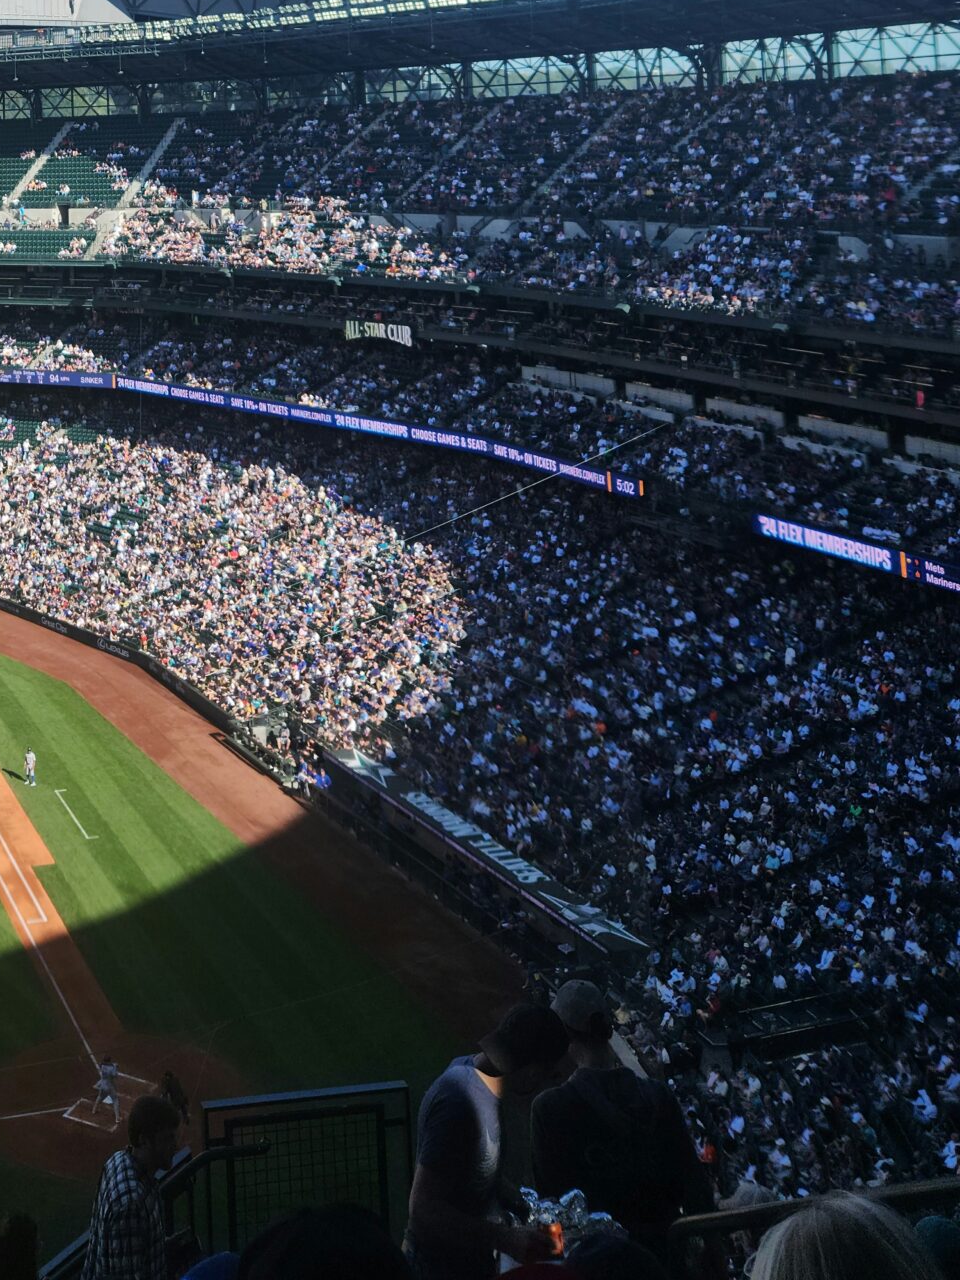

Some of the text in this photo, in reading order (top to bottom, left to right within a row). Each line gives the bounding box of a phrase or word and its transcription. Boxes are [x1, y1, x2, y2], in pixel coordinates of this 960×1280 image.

[388, 324, 412, 347] CLUB
[49, 374, 59, 384] 94
[80, 377, 104, 385] SINKER
[124, 378, 135, 389] FLEX
[135, 380, 169, 396] MEMBERSHIPS
[171, 387, 189, 398] CHOOSE
[189, 390, 205, 401] GAMES
[210, 394, 225, 405] SEATS
[231, 397, 244, 408] SAVE
[259, 402, 267, 413] ON
[268, 403, 289, 416] TICKETS
[346, 417, 360, 429] FLEX
[361, 419, 408, 438] MEMBERSHIPS
[411, 428, 437, 443] CHOOSE
[437, 431, 460, 447] GAMES
[461, 436, 466, 448] &
[467, 438, 488, 452] SEATS
[494, 444, 508, 458] SAVE
[524, 453, 533, 466] ON
[534, 455, 557, 471] TICKETS
[616, 479, 635, 495] 5:02
[777, 521, 802, 545] FLEX
[804, 528, 892, 571] MEMBERSHIPS
[925, 561, 945, 575] Mets
[926, 573, 960, 592] Mariners
[106, 643, 130, 658] LEXUS
